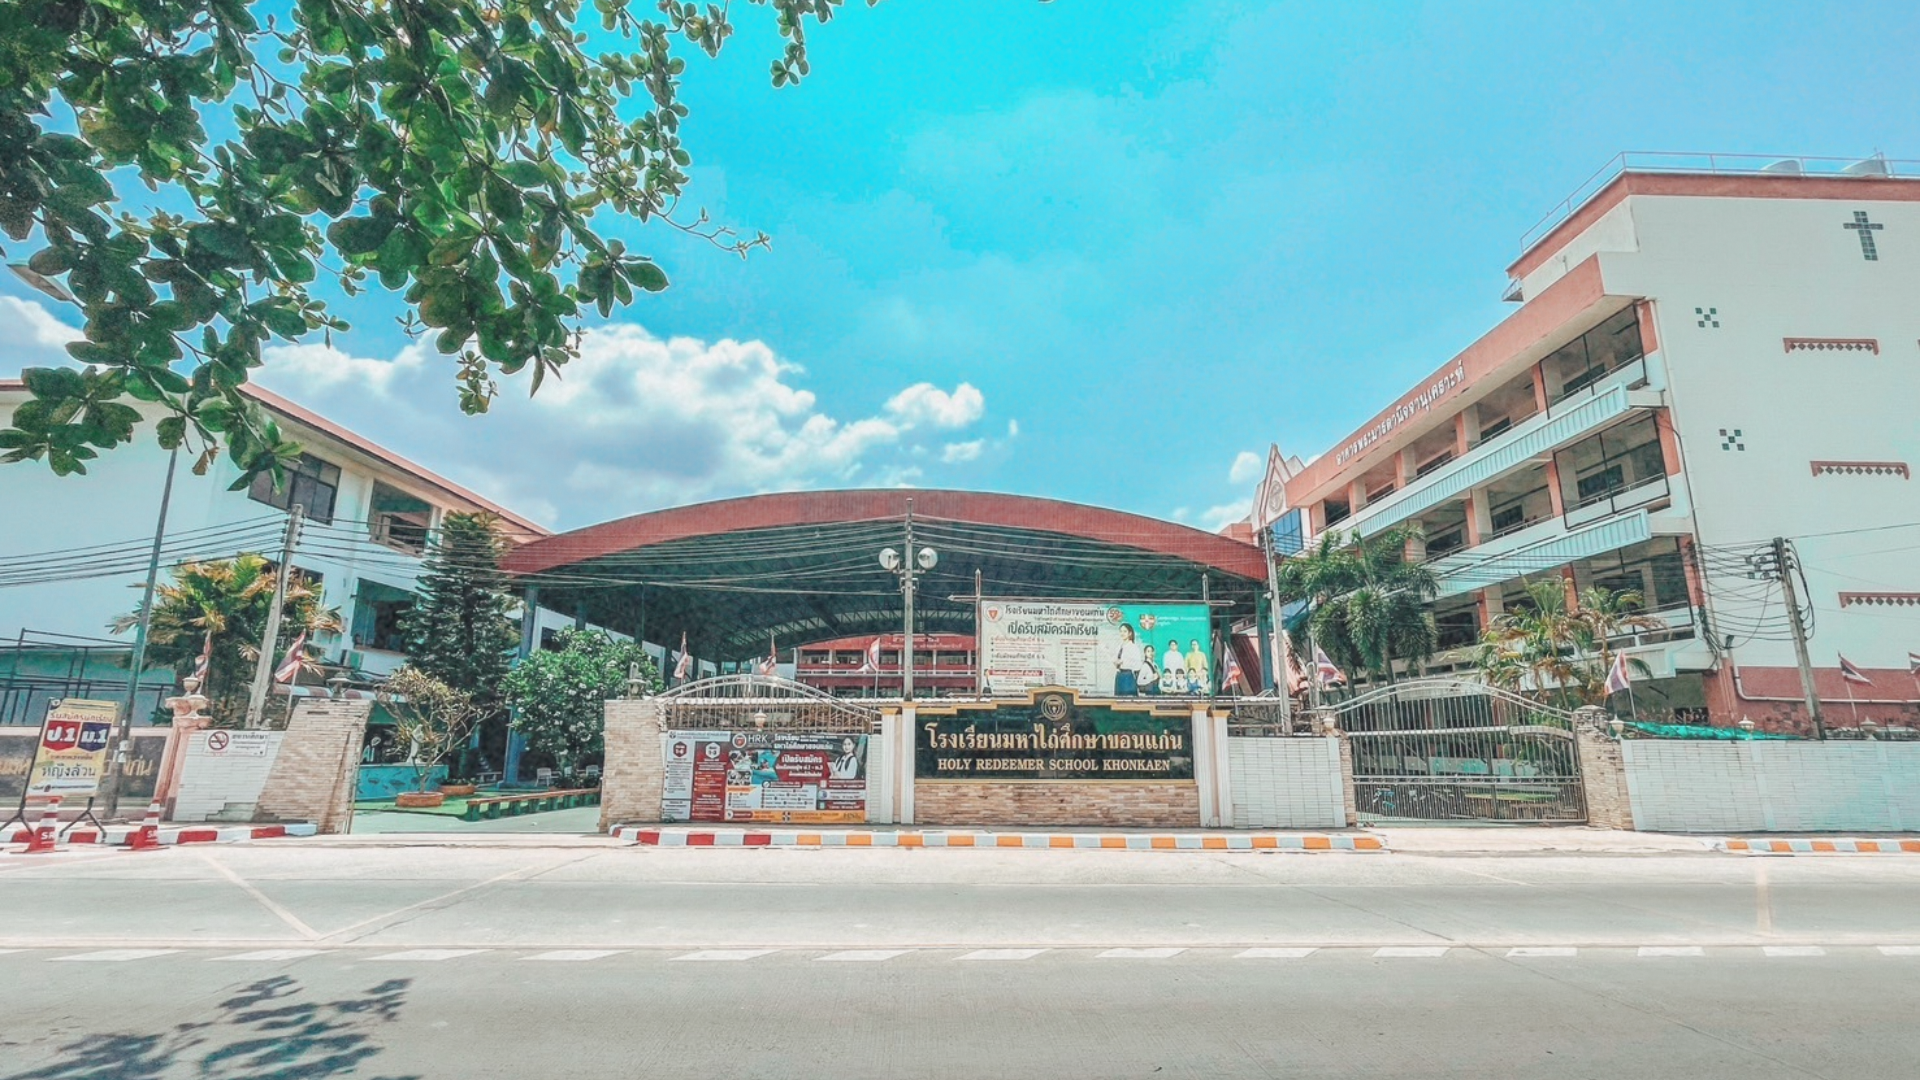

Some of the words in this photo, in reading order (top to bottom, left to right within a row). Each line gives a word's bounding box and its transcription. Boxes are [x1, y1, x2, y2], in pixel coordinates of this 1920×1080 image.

[1008, 621, 1099, 636] เปิดรับสมัครนักเรียน
[47, 726, 75, 742] ป.1
[81, 729, 107, 743] ม.1
[748, 734, 768, 744] HRK
[925, 722, 1183, 750] โรงเรียนมหาไถ่ศึกษาขอนแก่น
[938, 758, 971, 771] HOLY
[976, 758, 1045, 771] REDEEMER
[1049, 758, 1099, 771] SCHOOL
[1102, 758, 1171, 771] KHONKAEN
